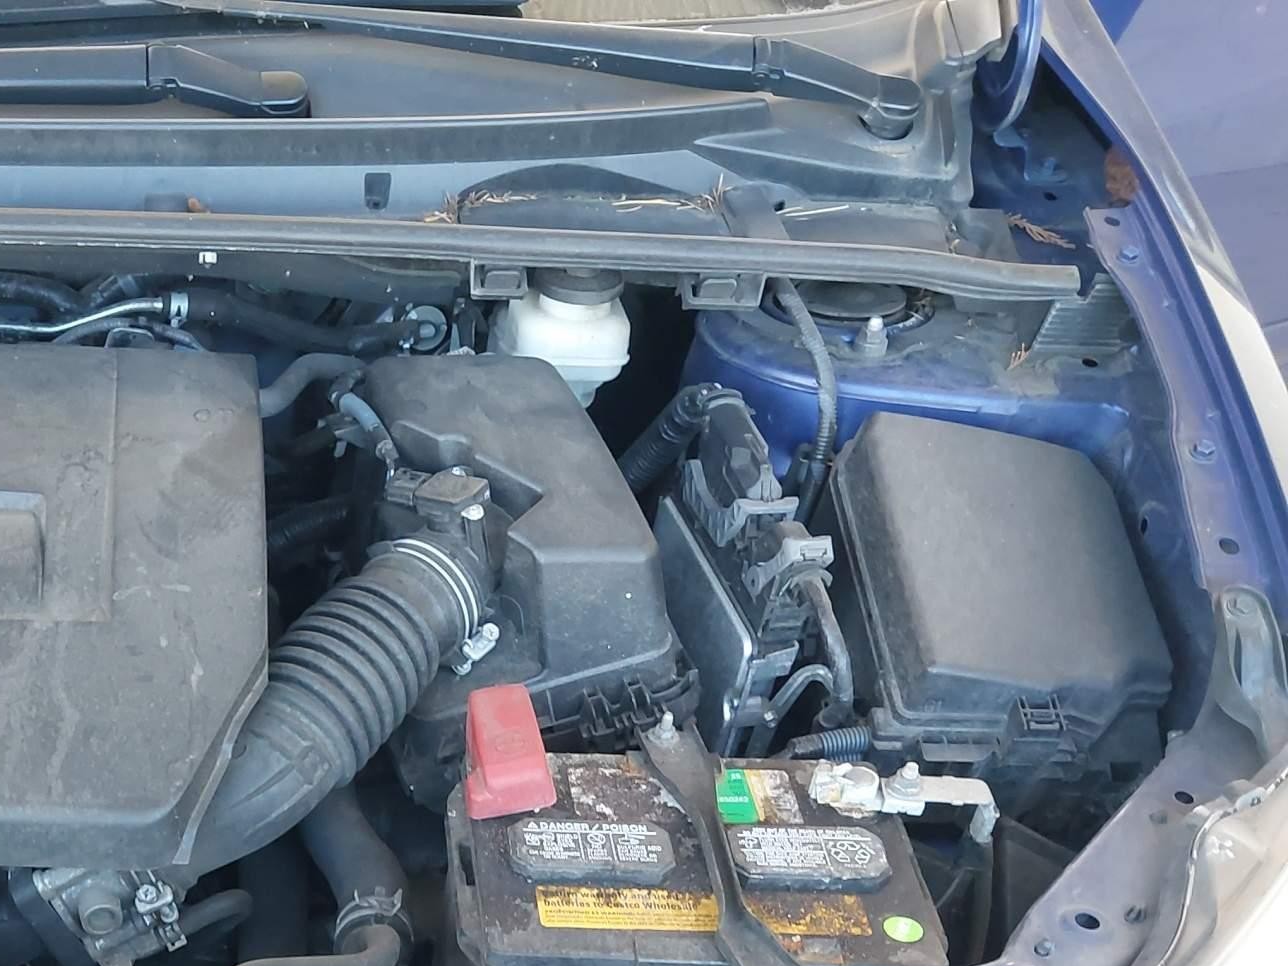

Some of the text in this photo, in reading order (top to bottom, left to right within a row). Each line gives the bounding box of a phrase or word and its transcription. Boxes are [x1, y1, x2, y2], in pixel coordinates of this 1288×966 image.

[539, 821, 648, 833] DANGER / POISON
[544, 898, 698, 911] batteries to Costco Wholesale
